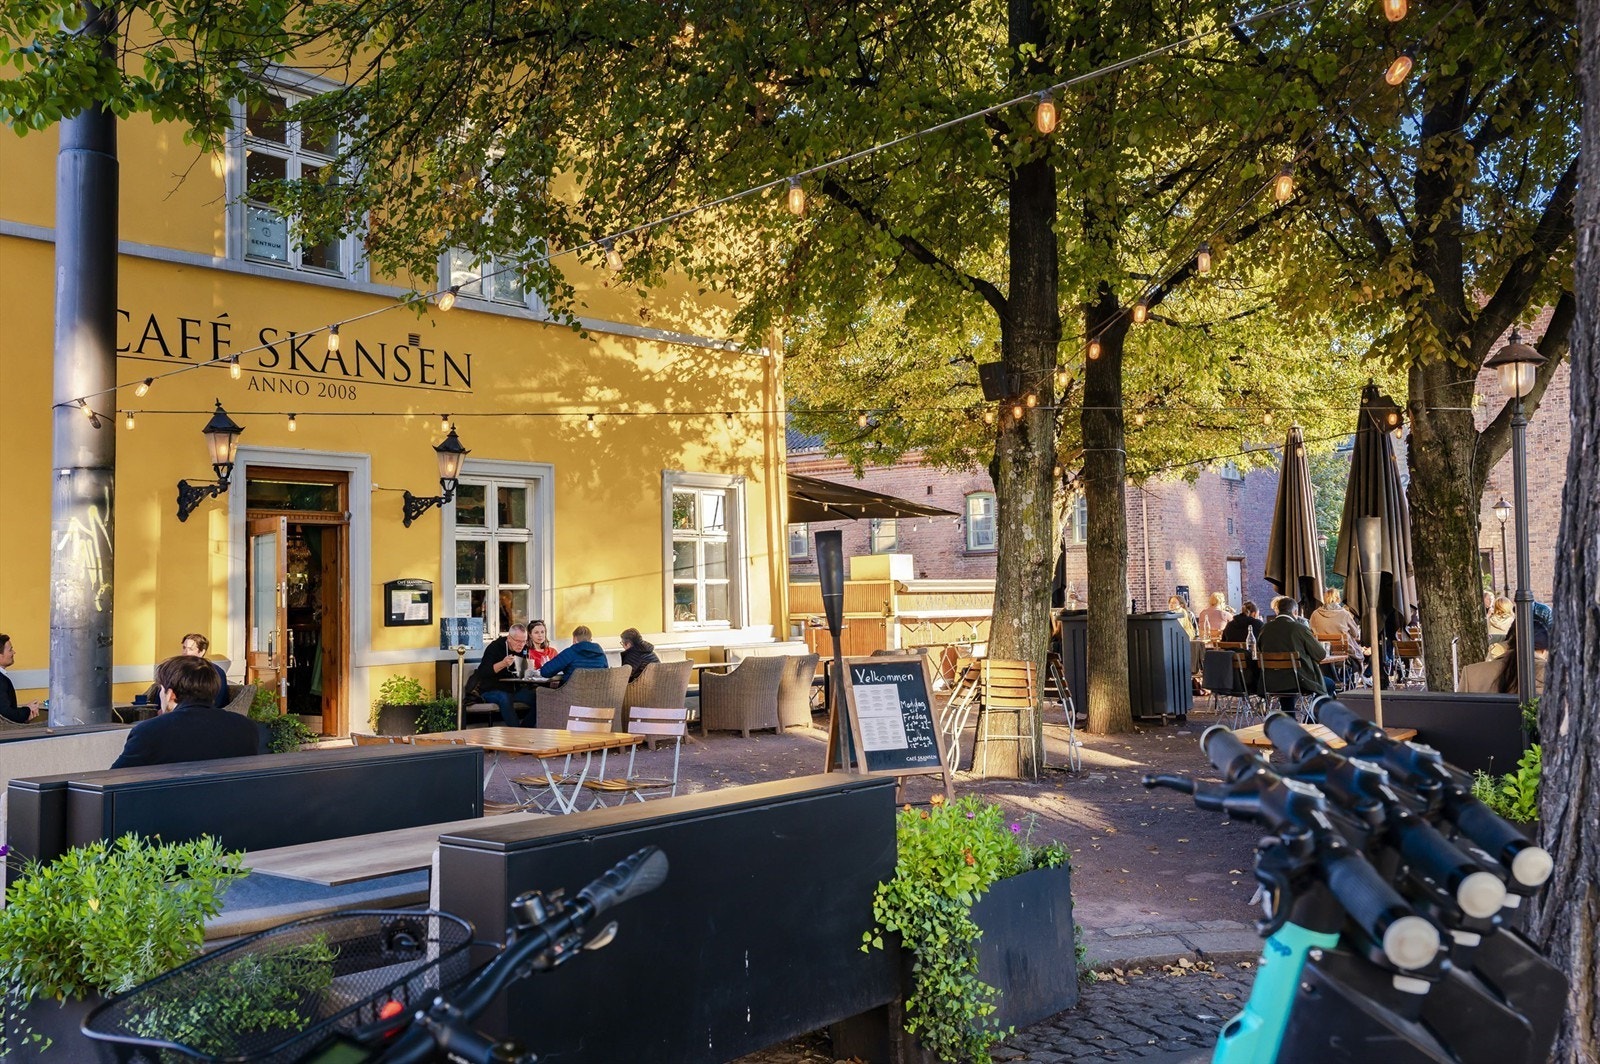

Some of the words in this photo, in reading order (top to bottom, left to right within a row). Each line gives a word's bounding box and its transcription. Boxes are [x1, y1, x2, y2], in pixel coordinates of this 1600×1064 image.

[251, 239, 281, 249] SENTRUM
[258, 327, 472, 389] SKANSEN
[247, 375, 310, 396] ANNO
[317, 382, 357, 401] 2008
[855, 669, 914, 683] Velkommen
[903, 713, 927, 722] Fredag
